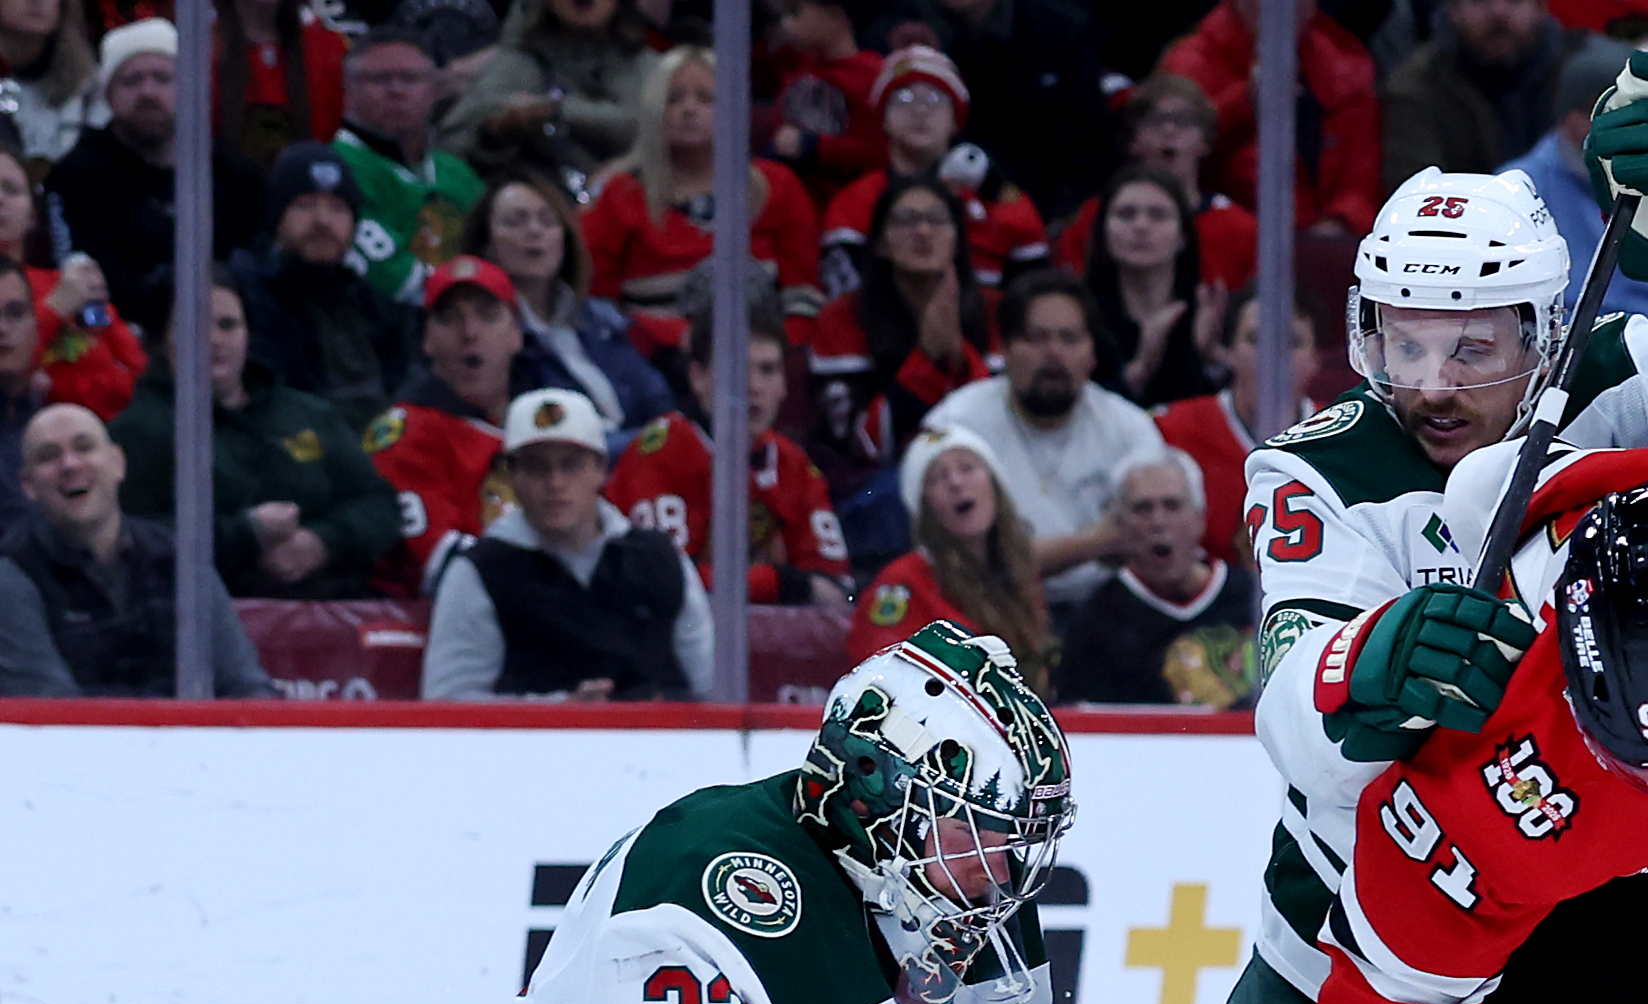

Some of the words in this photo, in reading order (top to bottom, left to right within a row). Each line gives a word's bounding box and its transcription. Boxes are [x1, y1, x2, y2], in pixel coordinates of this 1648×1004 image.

[1416, 196, 1469, 219] 25
[1403, 263, 1461, 275] CCM
[1573, 625, 1591, 667] TIRE
[1580, 616, 1604, 673] BELLE
[730, 857, 796, 917] MINNESOTA
[713, 892, 751, 924] WILD
